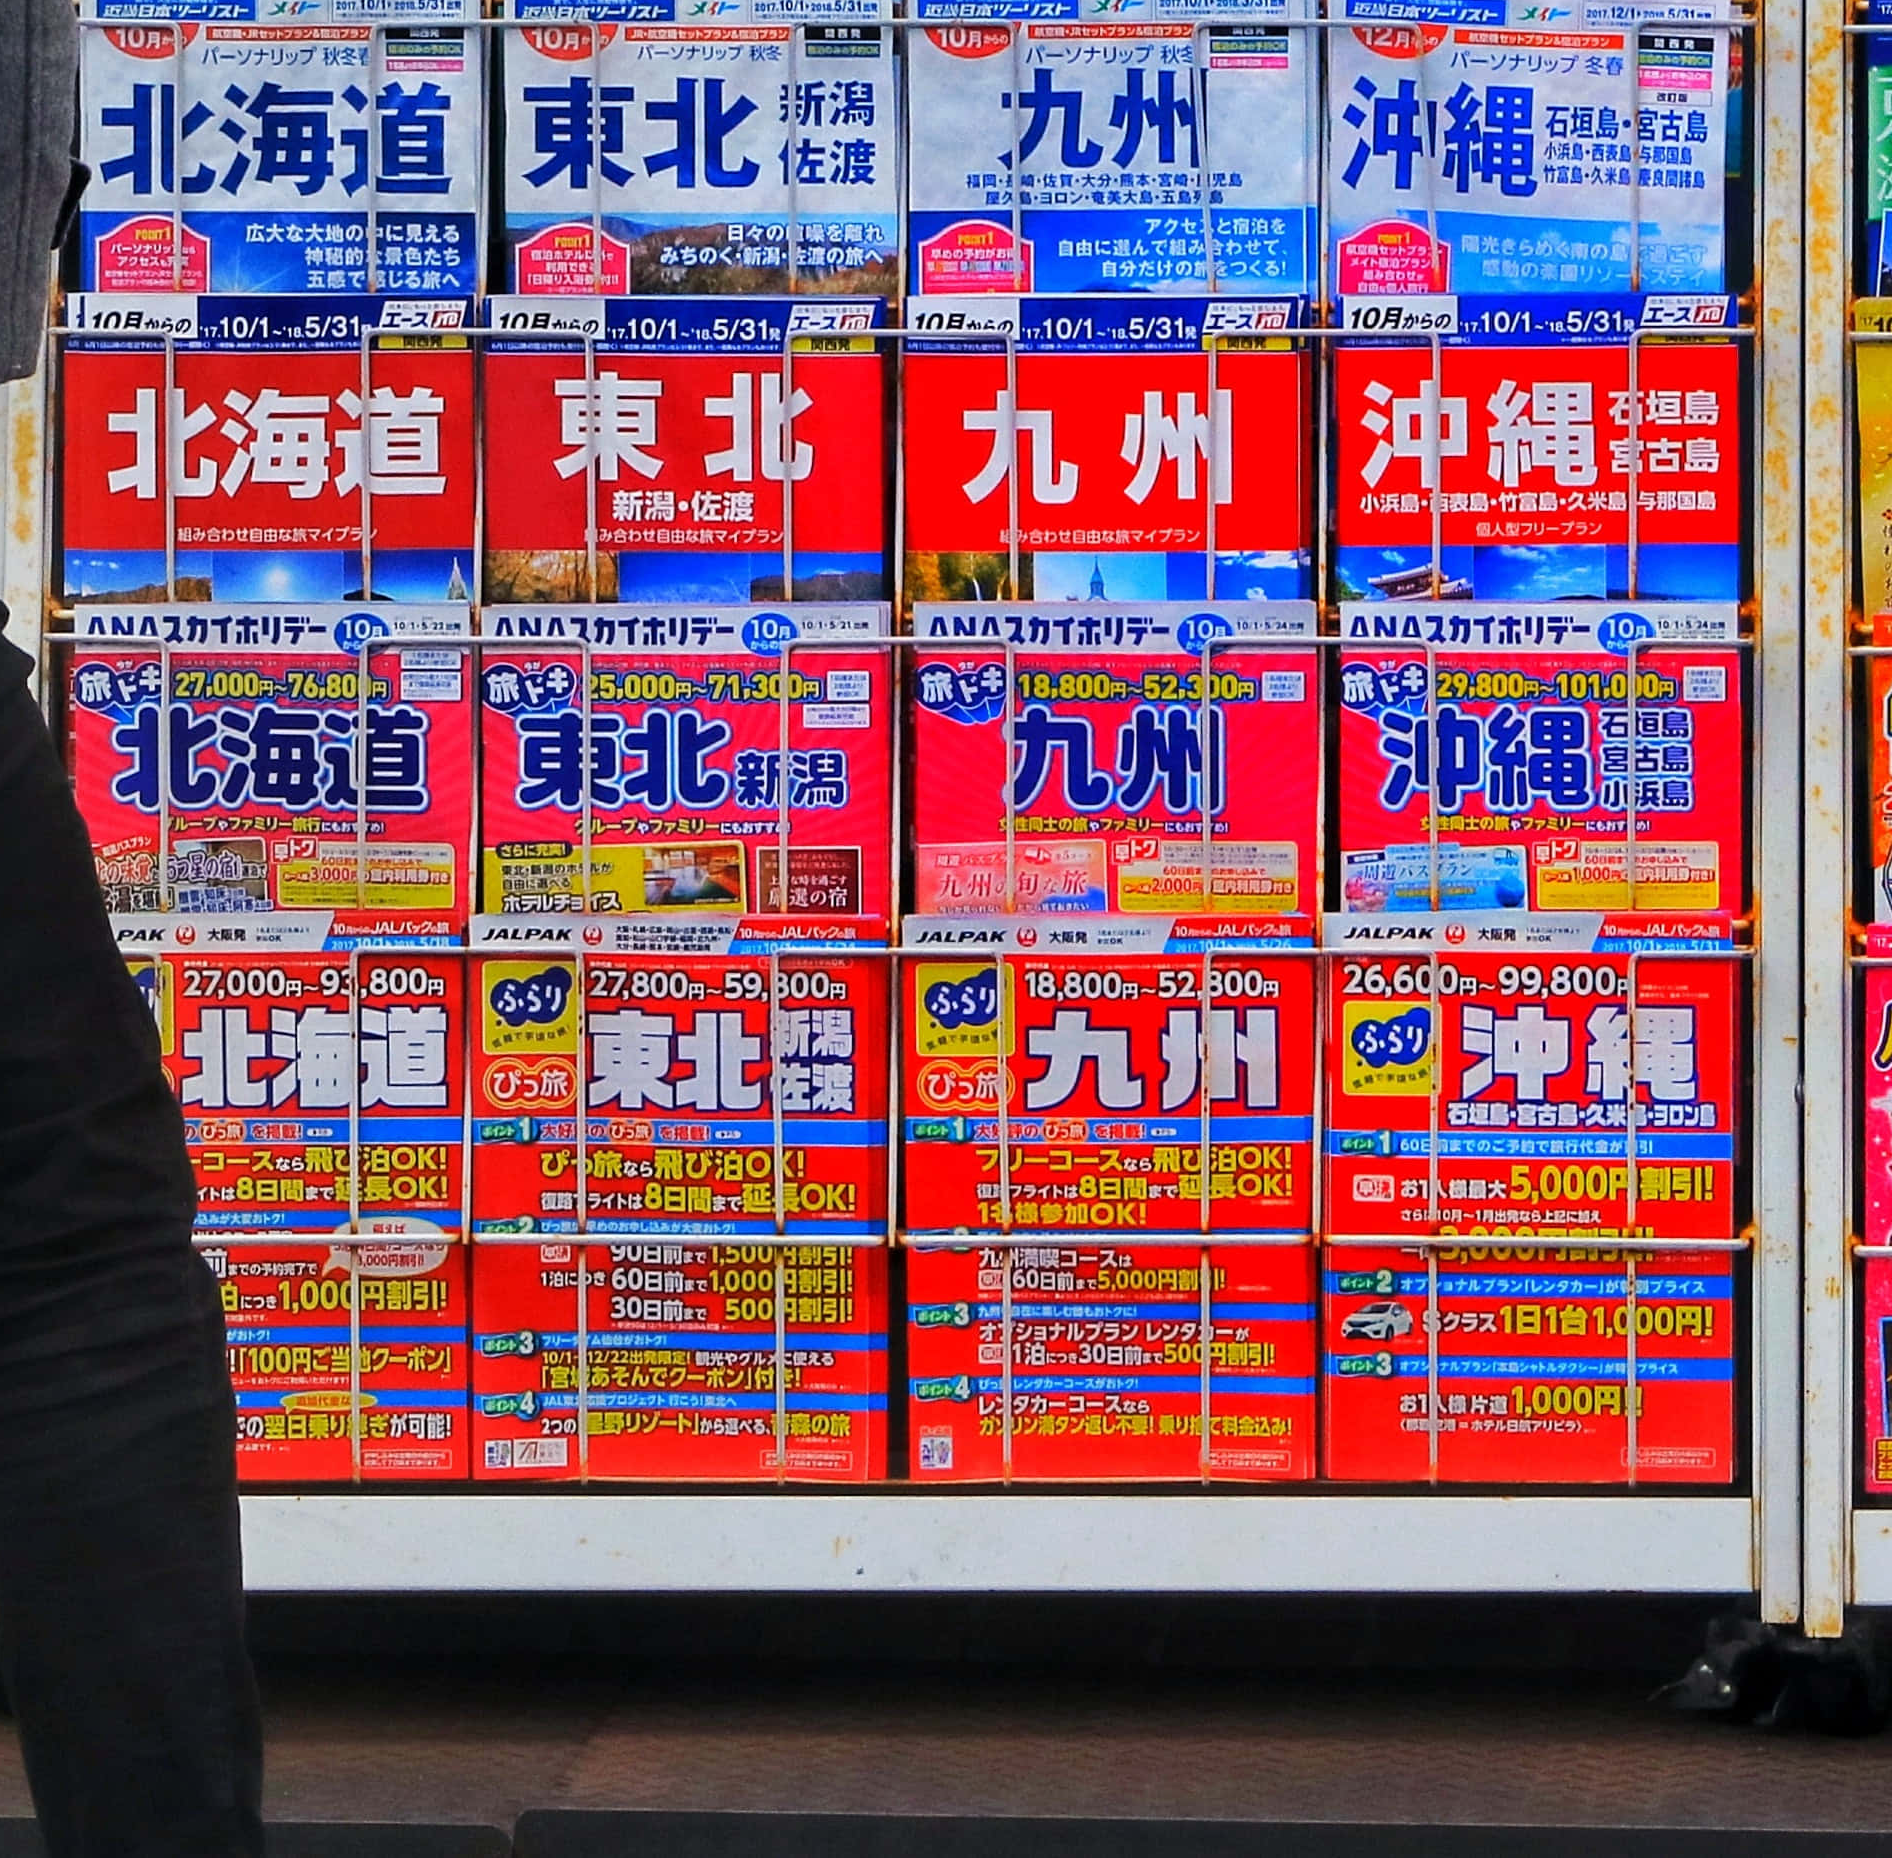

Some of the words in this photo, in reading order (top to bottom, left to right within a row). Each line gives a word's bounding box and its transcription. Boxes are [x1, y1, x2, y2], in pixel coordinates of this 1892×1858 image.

[202, 46, 316, 66] パーソナリップ
[100, 83, 452, 198] 北海道
[523, 77, 759, 191] 東北
[998, 70, 1209, 170] 九州
[1342, 75, 1538, 198] 沖縄
[108, 387, 447, 500] 北海道
[554, 372, 815, 482] 東北
[962, 389, 1232, 507] 九州
[1361, 380, 1596, 489] 沖縄
[1476, 521, 1603, 539] 個人型フリープラン
[113, 709, 428, 811] 北海道
[516, 711, 732, 811] 東北
[1010, 708, 1224, 813] 九州
[915, 928, 1005, 944] JALPAK
[182, 1007, 448, 1110] 北海道
[1462, 1007, 1697, 1101] 沖縄
